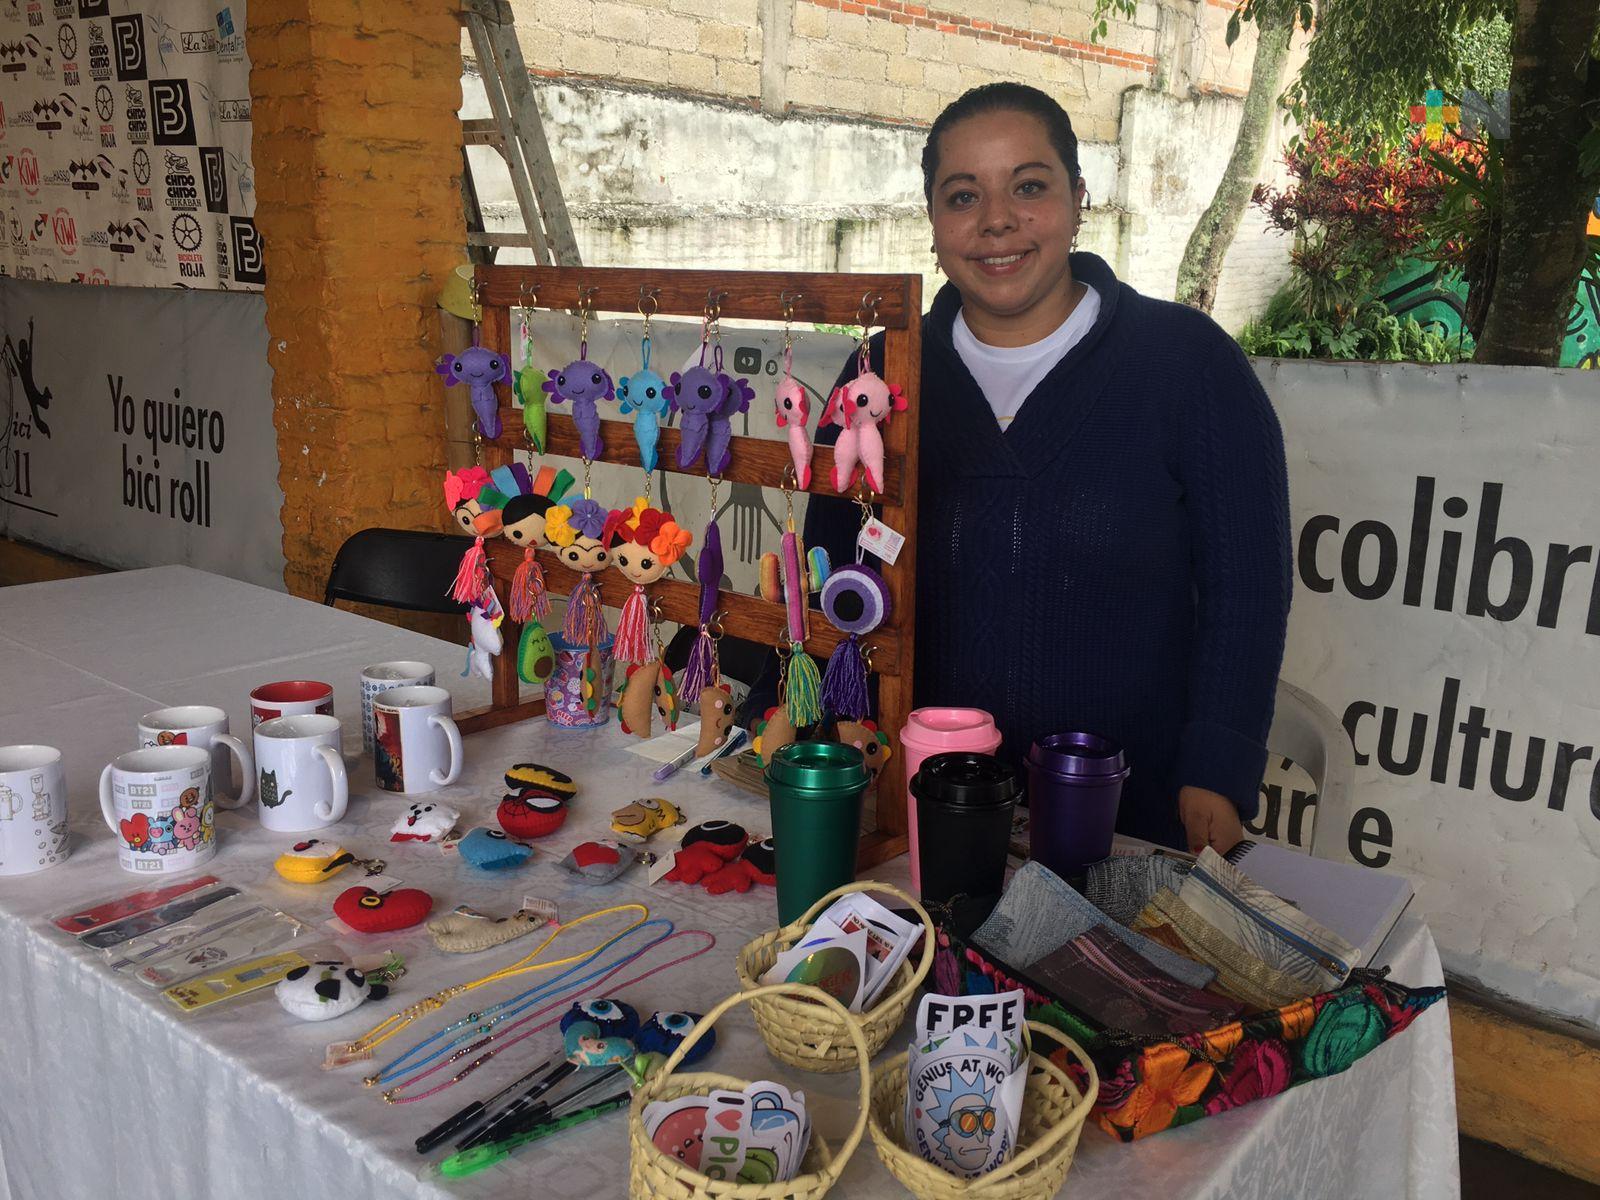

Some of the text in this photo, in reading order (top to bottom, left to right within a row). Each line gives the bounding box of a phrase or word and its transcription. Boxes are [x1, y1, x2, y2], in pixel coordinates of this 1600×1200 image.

[165, 174, 196, 187] CHIDO
[166, 186, 197, 199] CHIDO
[178, 262, 206, 278] ROJA
[107, 374, 225, 456] Yo quiero
[122, 443, 211, 528] bici roll
[1342, 677, 1600, 822] cultur
[915, 1061, 953, 1102] GENIUS
[960, 1059, 981, 1073] AT
